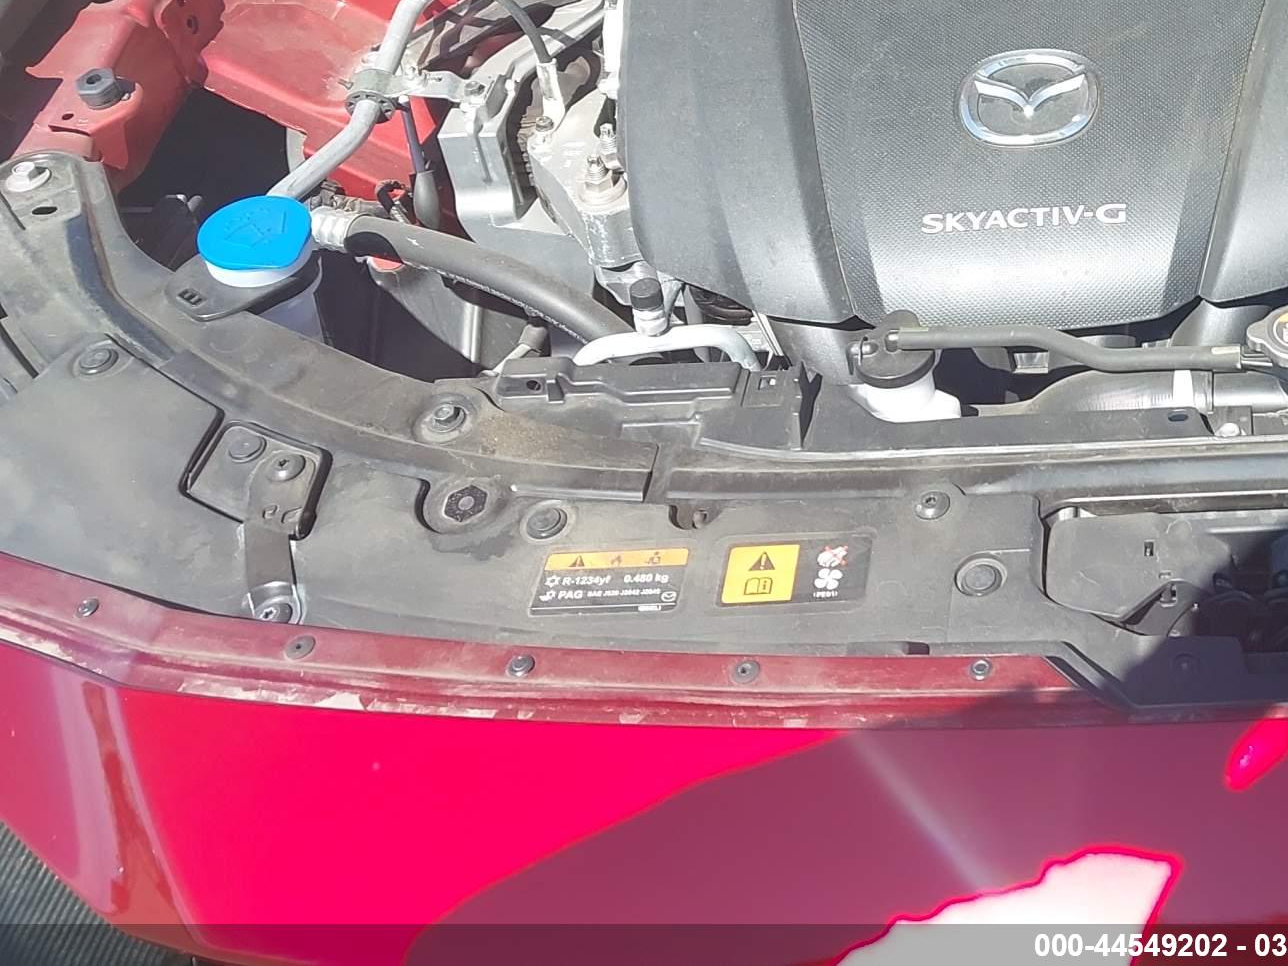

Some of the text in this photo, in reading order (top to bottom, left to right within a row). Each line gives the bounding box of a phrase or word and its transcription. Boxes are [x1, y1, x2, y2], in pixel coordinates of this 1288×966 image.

[921, 203, 1127, 234] SKYACTIV-G
[562, 574, 612, 586] R-1234yf
[654, 573, 669, 584] kg
[558, 589, 583, 600] PAG
